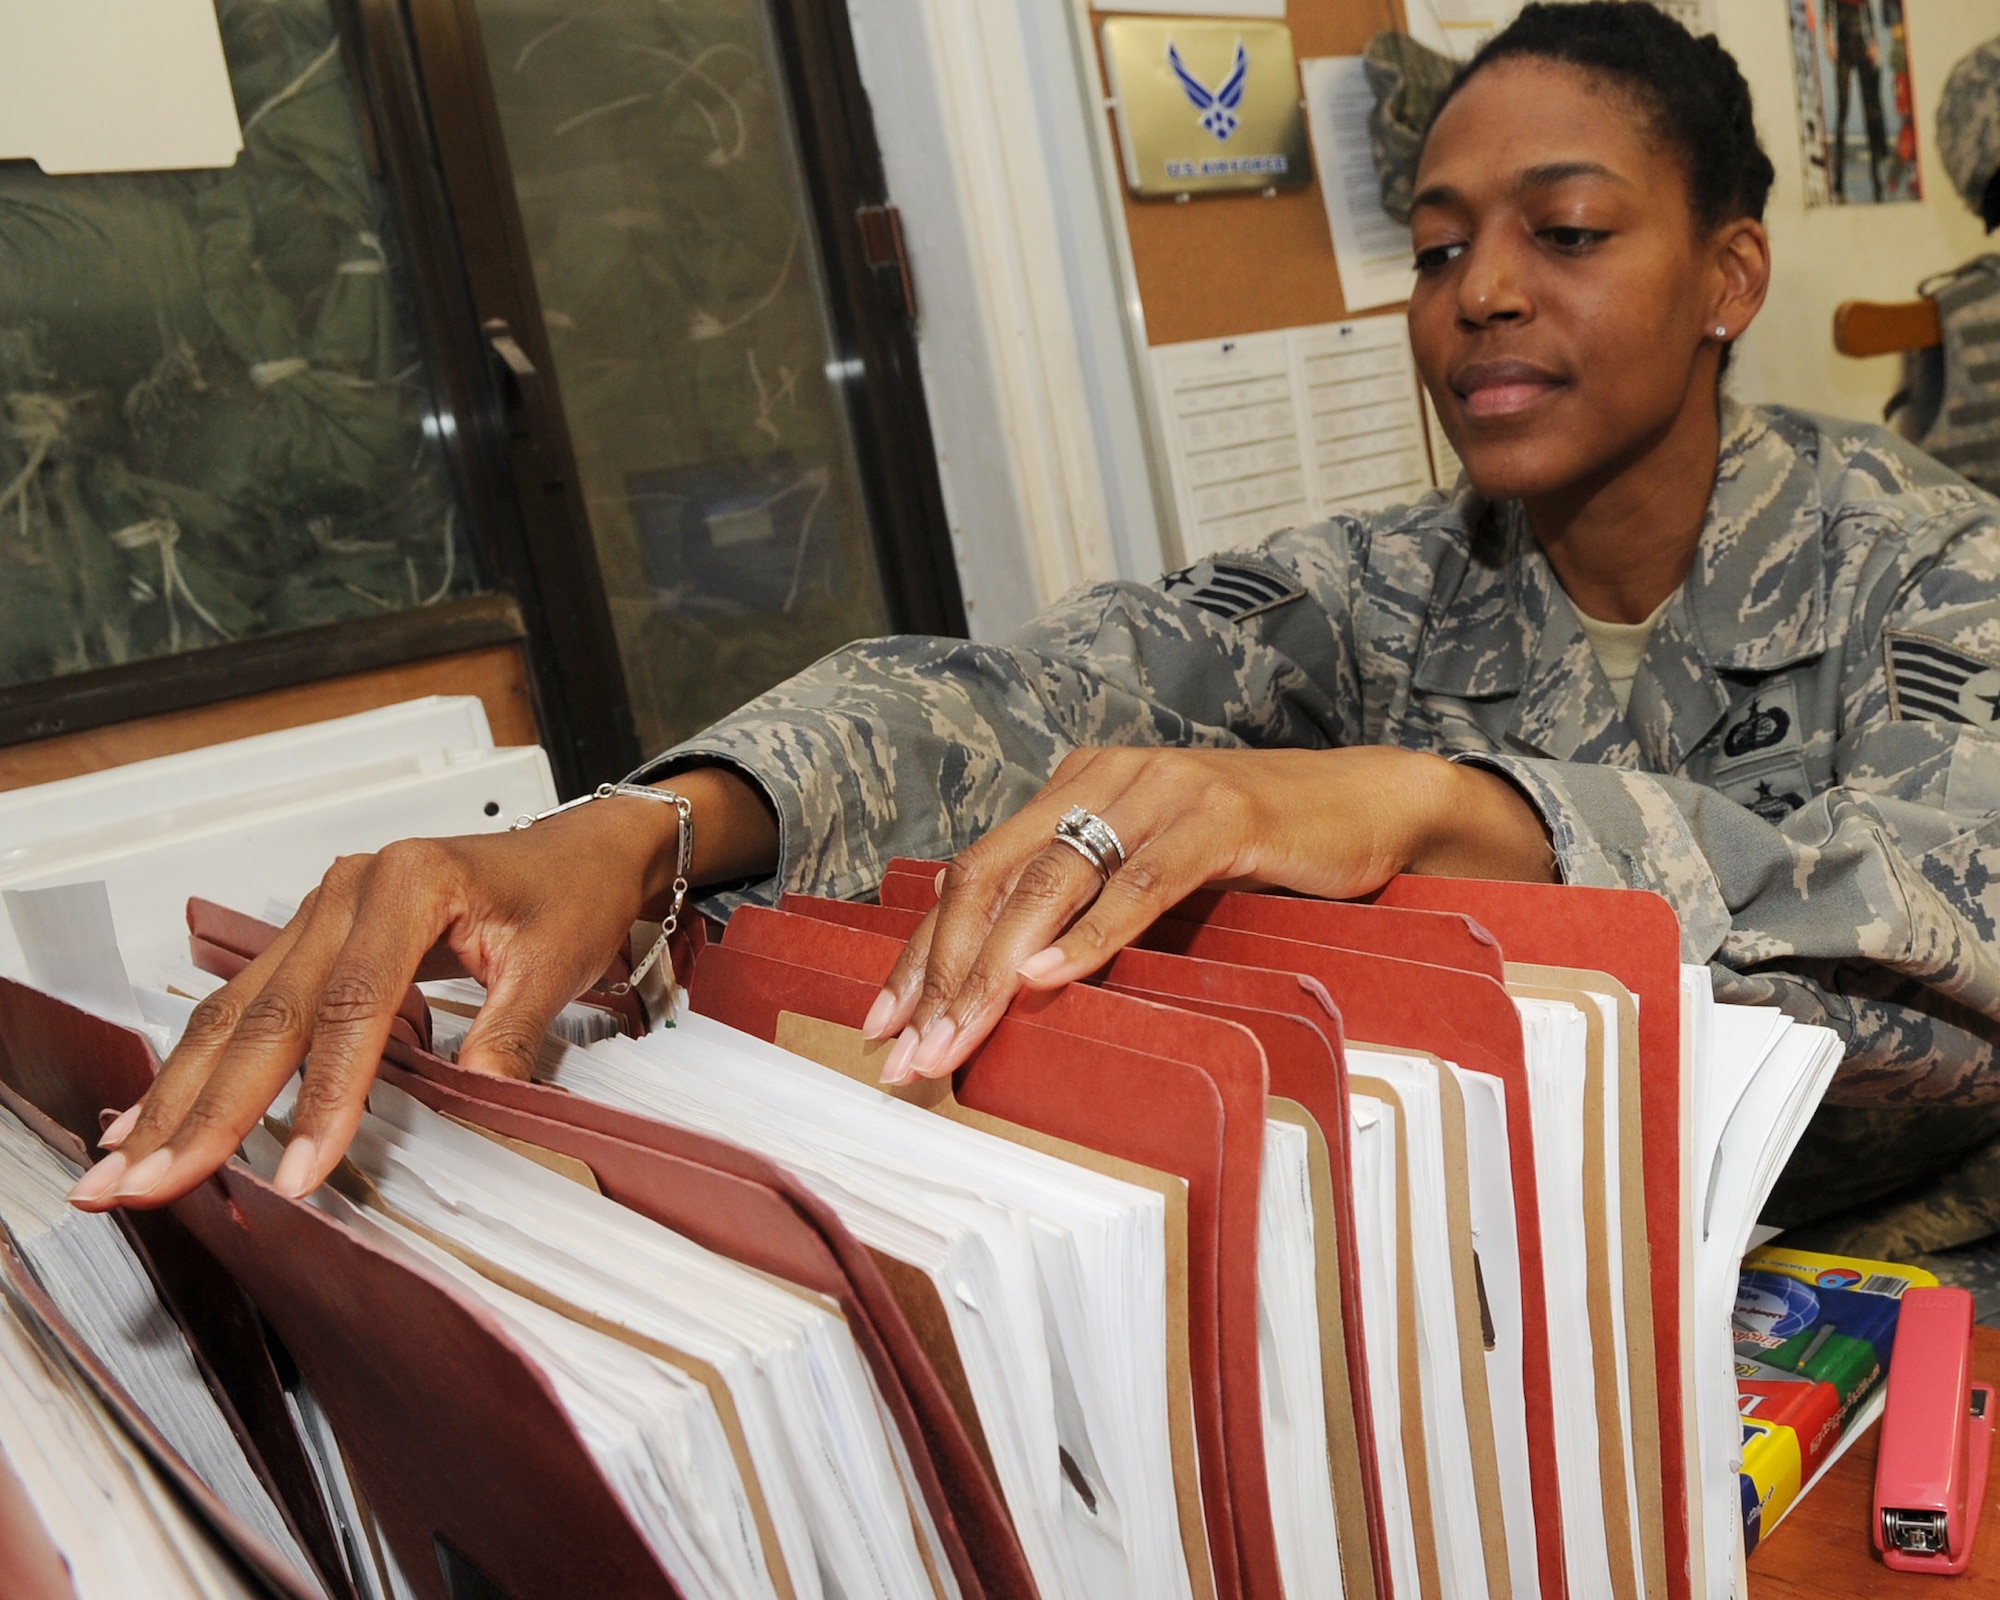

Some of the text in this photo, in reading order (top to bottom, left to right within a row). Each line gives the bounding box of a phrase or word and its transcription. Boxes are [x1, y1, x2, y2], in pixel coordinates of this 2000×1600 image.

[1166, 157, 1287, 178] U.S. AIR FORCE
